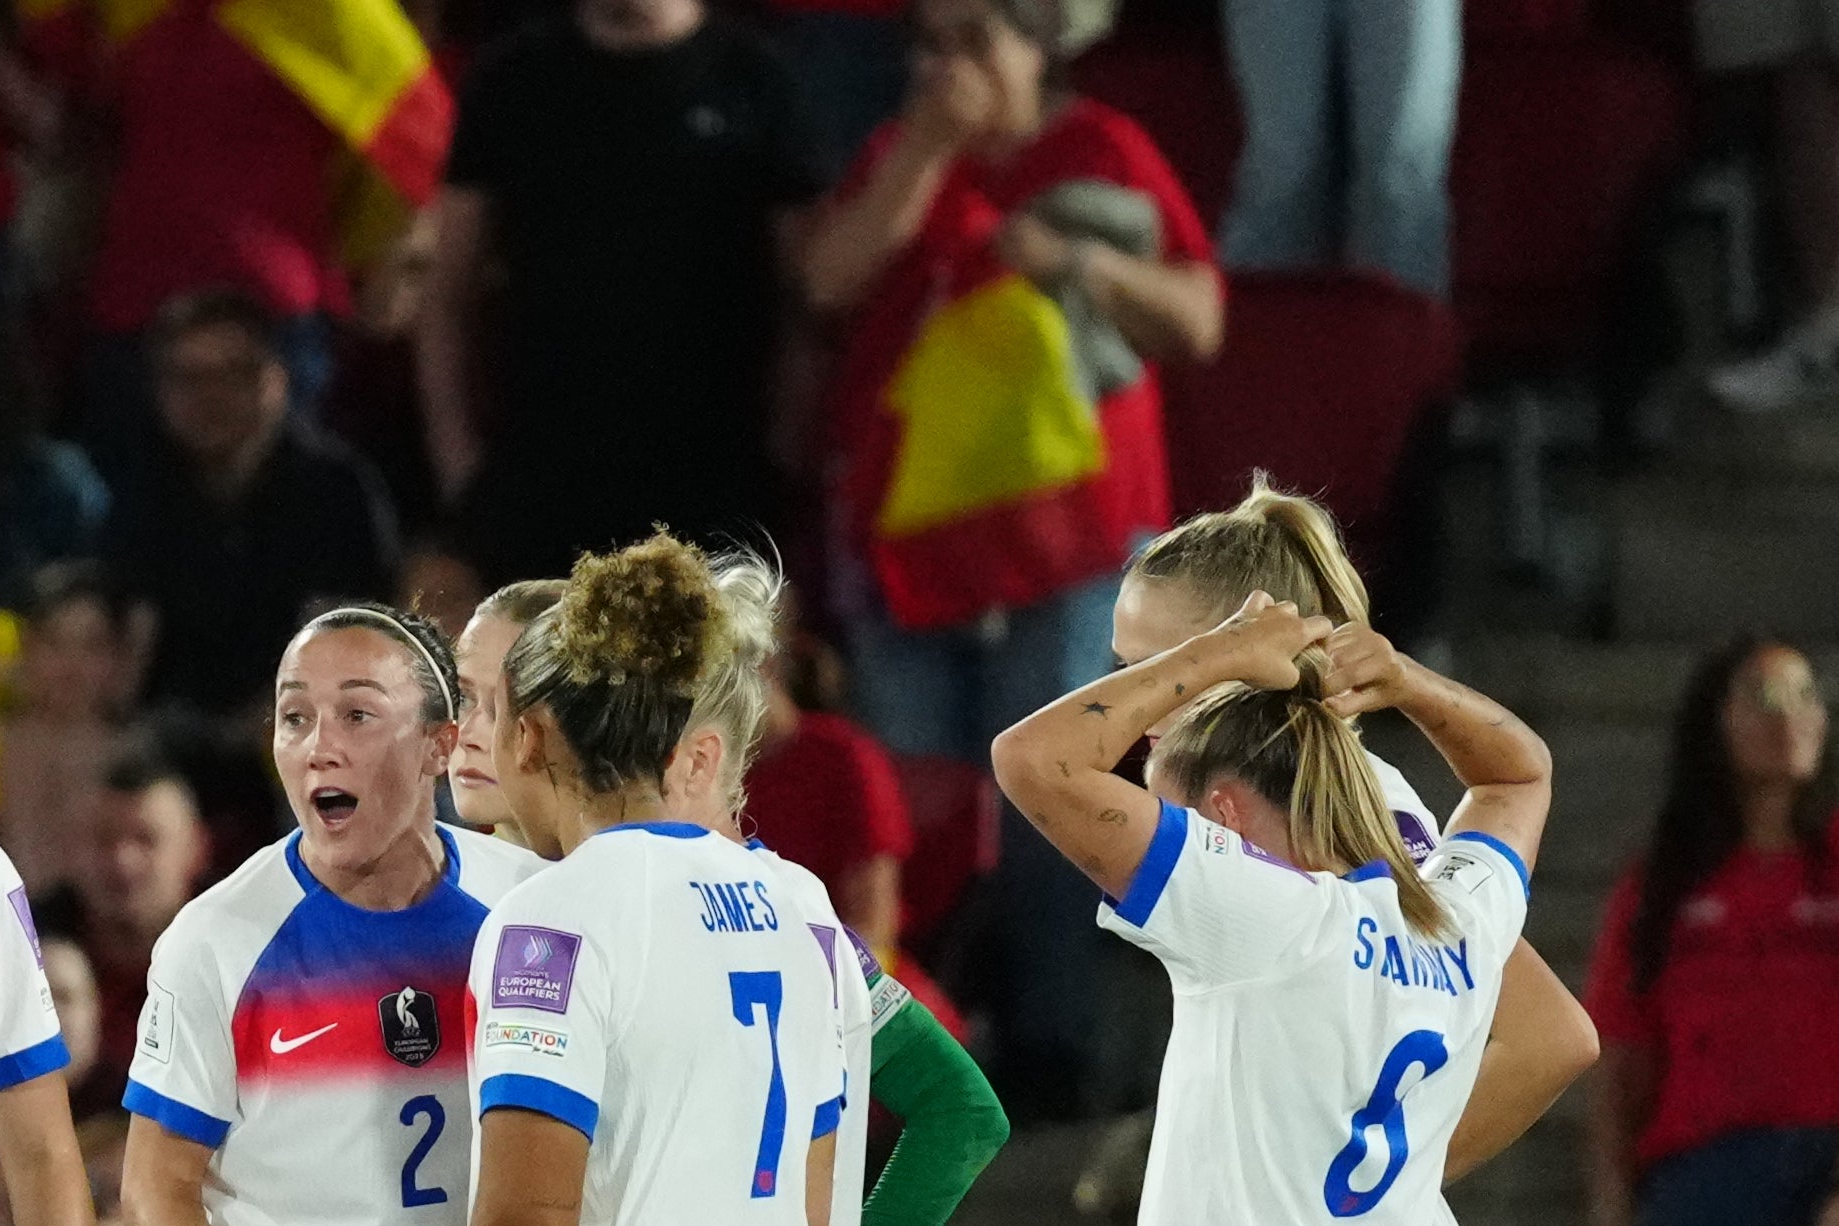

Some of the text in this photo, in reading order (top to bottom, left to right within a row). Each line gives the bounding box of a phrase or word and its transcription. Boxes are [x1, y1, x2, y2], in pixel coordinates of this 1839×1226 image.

[689, 881, 778, 932] JAMES
[498, 986, 561, 1001] QUALIFIERS
[500, 977, 561, 991] EUROPEAN
[728, 971, 787, 1199] 7
[399, 1094, 448, 1208] 2
